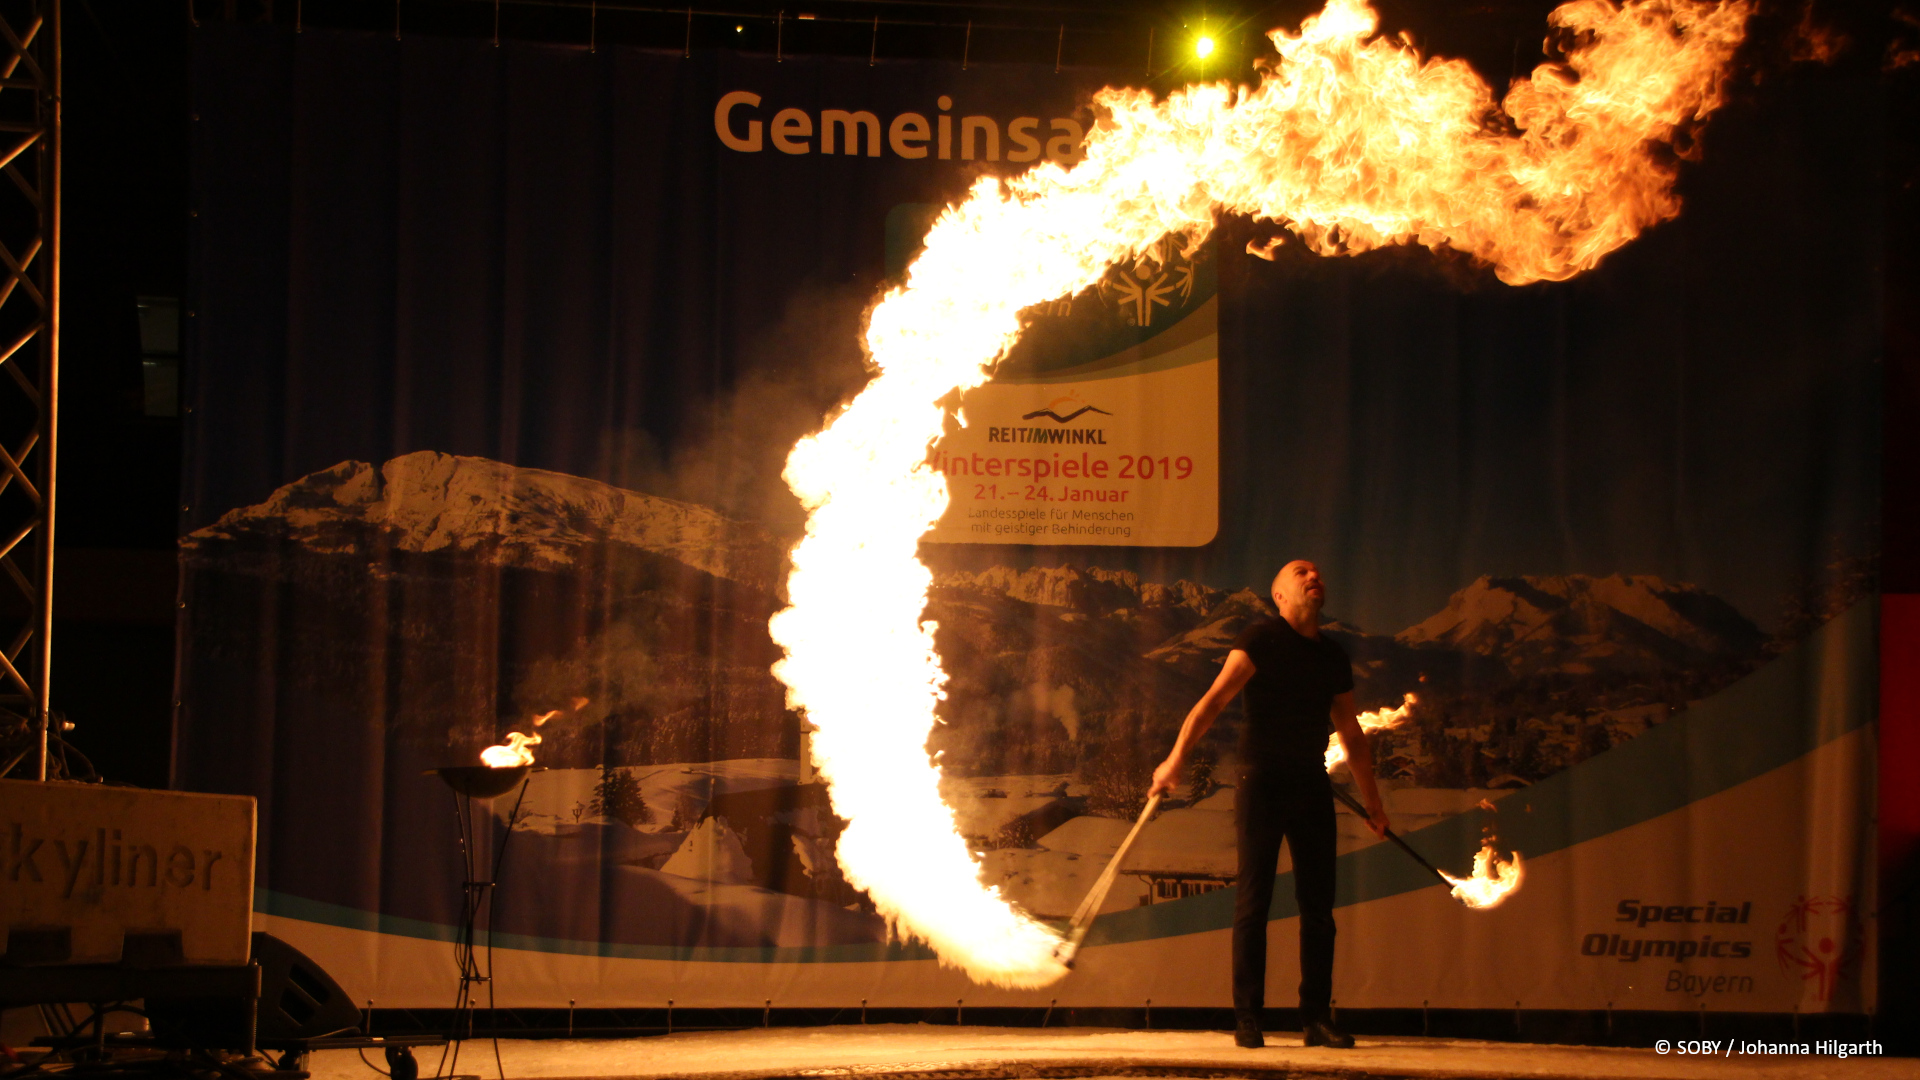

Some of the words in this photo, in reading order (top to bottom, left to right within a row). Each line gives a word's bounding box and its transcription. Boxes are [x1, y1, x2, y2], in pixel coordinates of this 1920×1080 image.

[714, 90, 1084, 165] Gemeinsa
[988, 427, 1107, 445] REITIMWINKL
[930, 451, 1109, 483] interspiele
[1118, 455, 1193, 480] 2019
[1058, 485, 1129, 503] Januar
[968, 507, 1046, 521] Landesspiele
[1050, 508, 1069, 520] für
[1072, 509, 1134, 521] Menschen
[971, 522, 991, 533] mit
[995, 522, 1050, 536] geistiger
[1052, 523, 1131, 537] Behinderung
[0, 822, 222, 899] kyliner
[1615, 899, 1752, 927] Special
[1580, 933, 1752, 962] Olympics
[1664, 970, 1754, 998] Bayern
